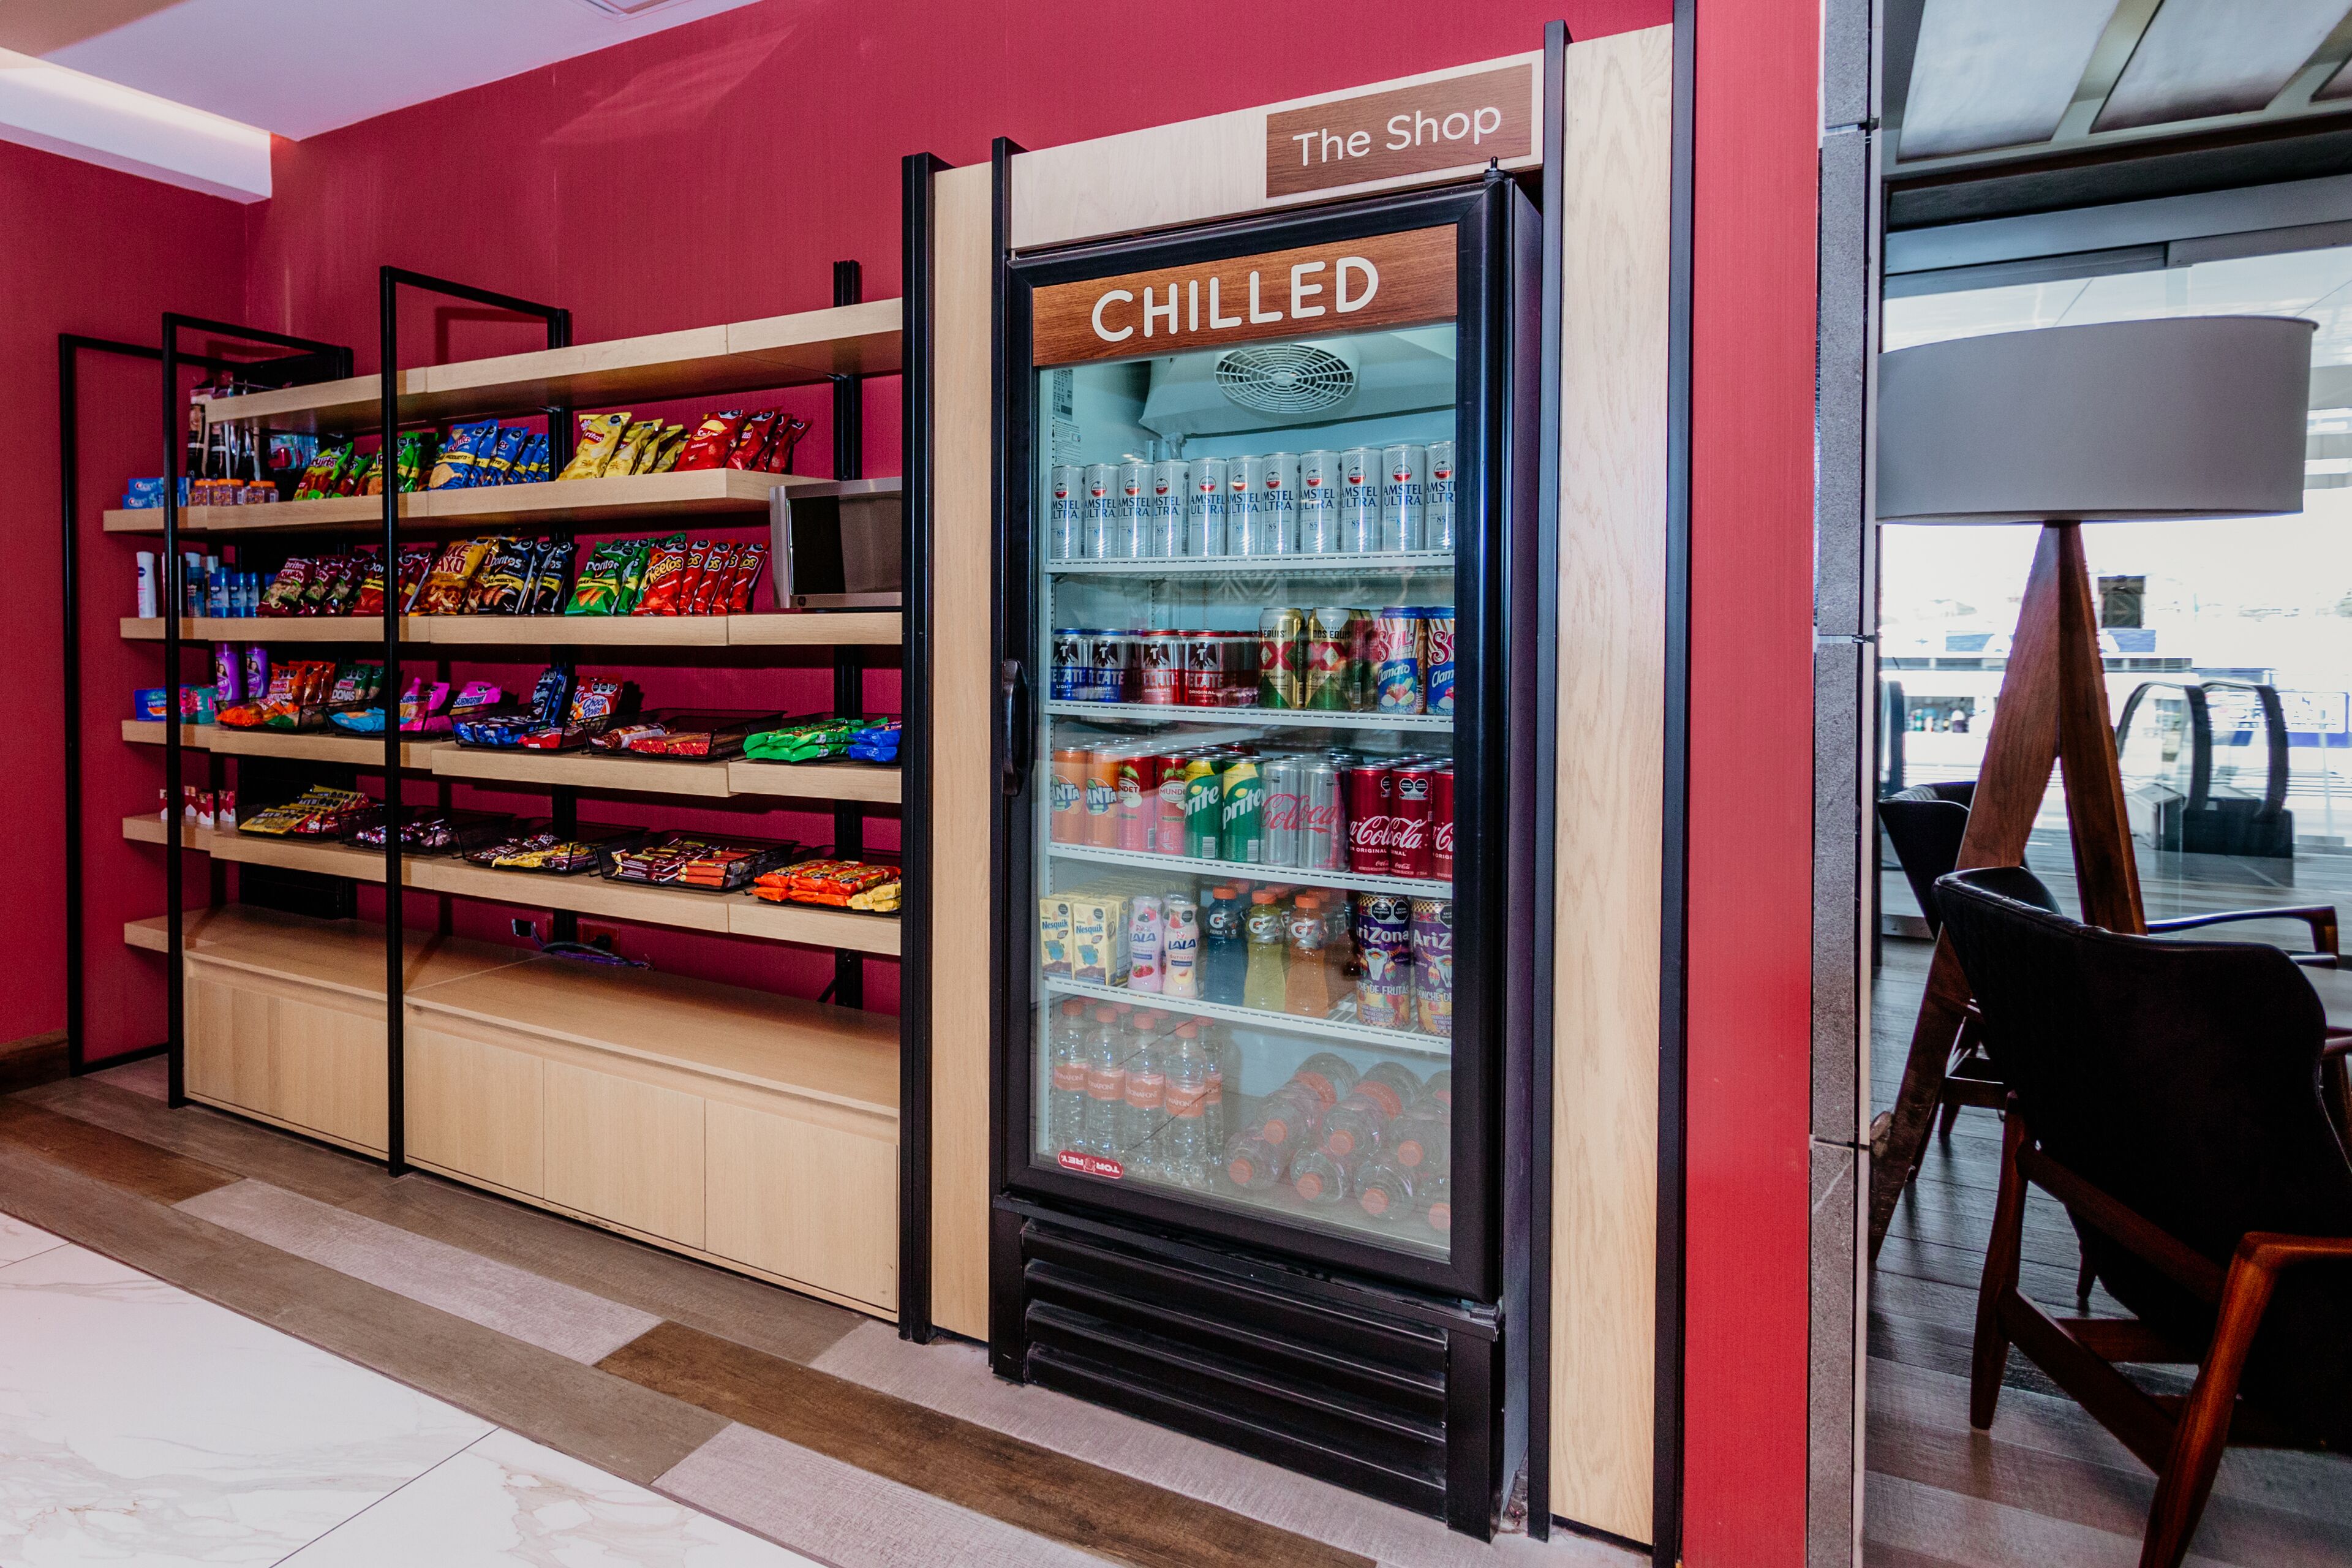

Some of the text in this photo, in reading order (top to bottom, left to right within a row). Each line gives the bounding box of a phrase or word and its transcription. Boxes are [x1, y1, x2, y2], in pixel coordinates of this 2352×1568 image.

[1293, 107, 1502, 166] The Shop
[1091, 256, 1379, 342] CHILLED
[1383, 484, 1423, 496] AMSTEL
[1191, 494, 1225, 505] AMSTEL
[1384, 495, 1423, 507] ULTRA
[585, 560, 620, 571] Doritos
[643, 557, 683, 589] Cheetos
[1313, 630, 1327, 638] DOS
[331, 690, 355, 701] DONAS
[582, 696, 607, 710] Choco
[1042, 920, 1069, 930] Nesquik
[1209, 913, 1225, 929] G
[1248, 918, 1265, 934] G
[1076, 923, 1103, 935] Nesquik
[1291, 921, 1308, 938] G
[1130, 932, 1156, 943] LALA
[1169, 938, 1196, 950] LALA
[1370, 984, 1379, 993] DE
[1061, 1155, 1120, 1174] TOR REY
